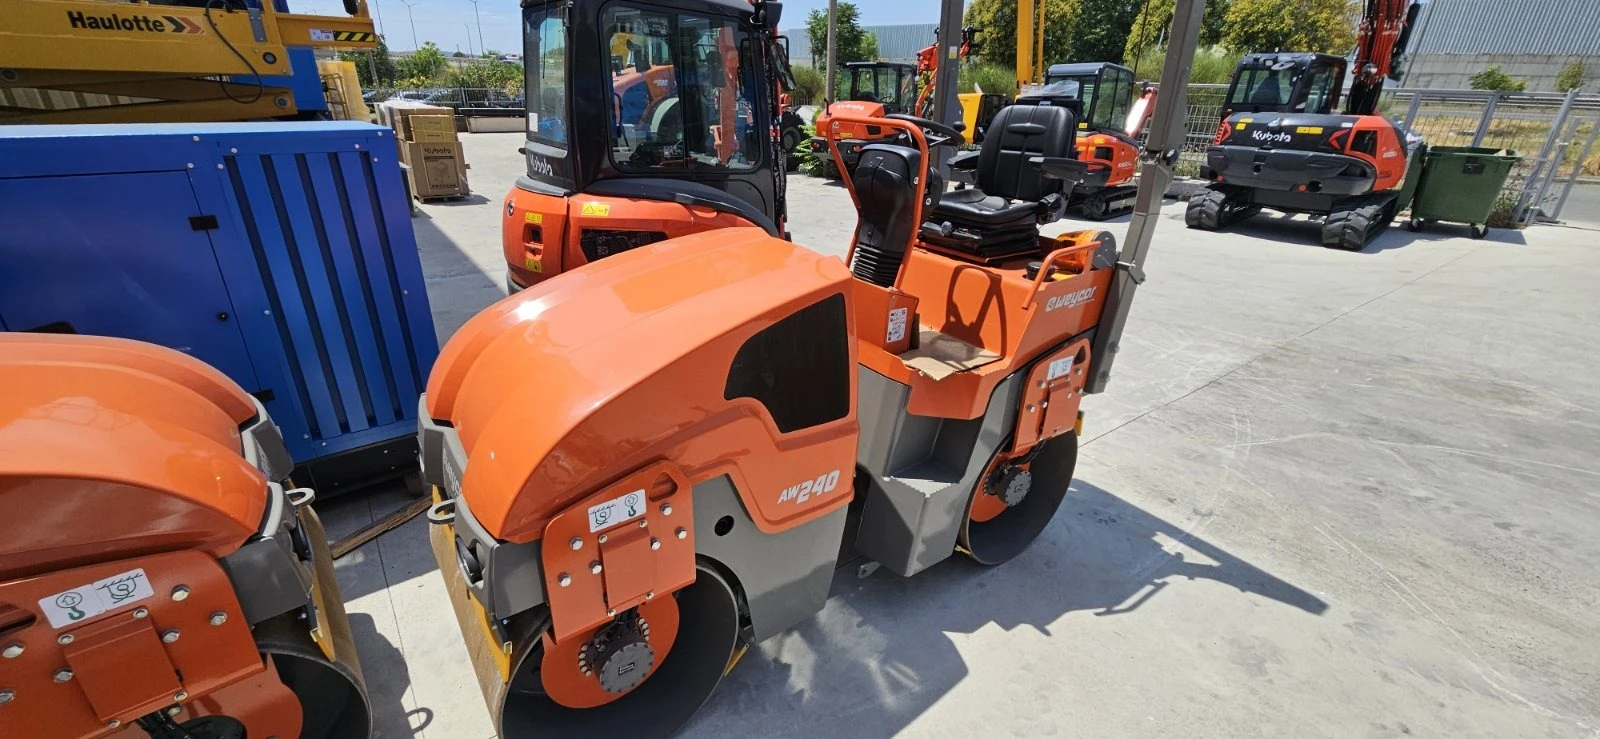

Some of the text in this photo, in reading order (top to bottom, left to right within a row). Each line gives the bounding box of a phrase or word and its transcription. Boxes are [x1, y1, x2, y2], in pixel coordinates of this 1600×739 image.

[67, 10, 165, 32] Haulotte
[1252, 130, 1292, 143] Kubota
[1054, 286, 1097, 309] weycor
[776, 469, 840, 504] AW240
